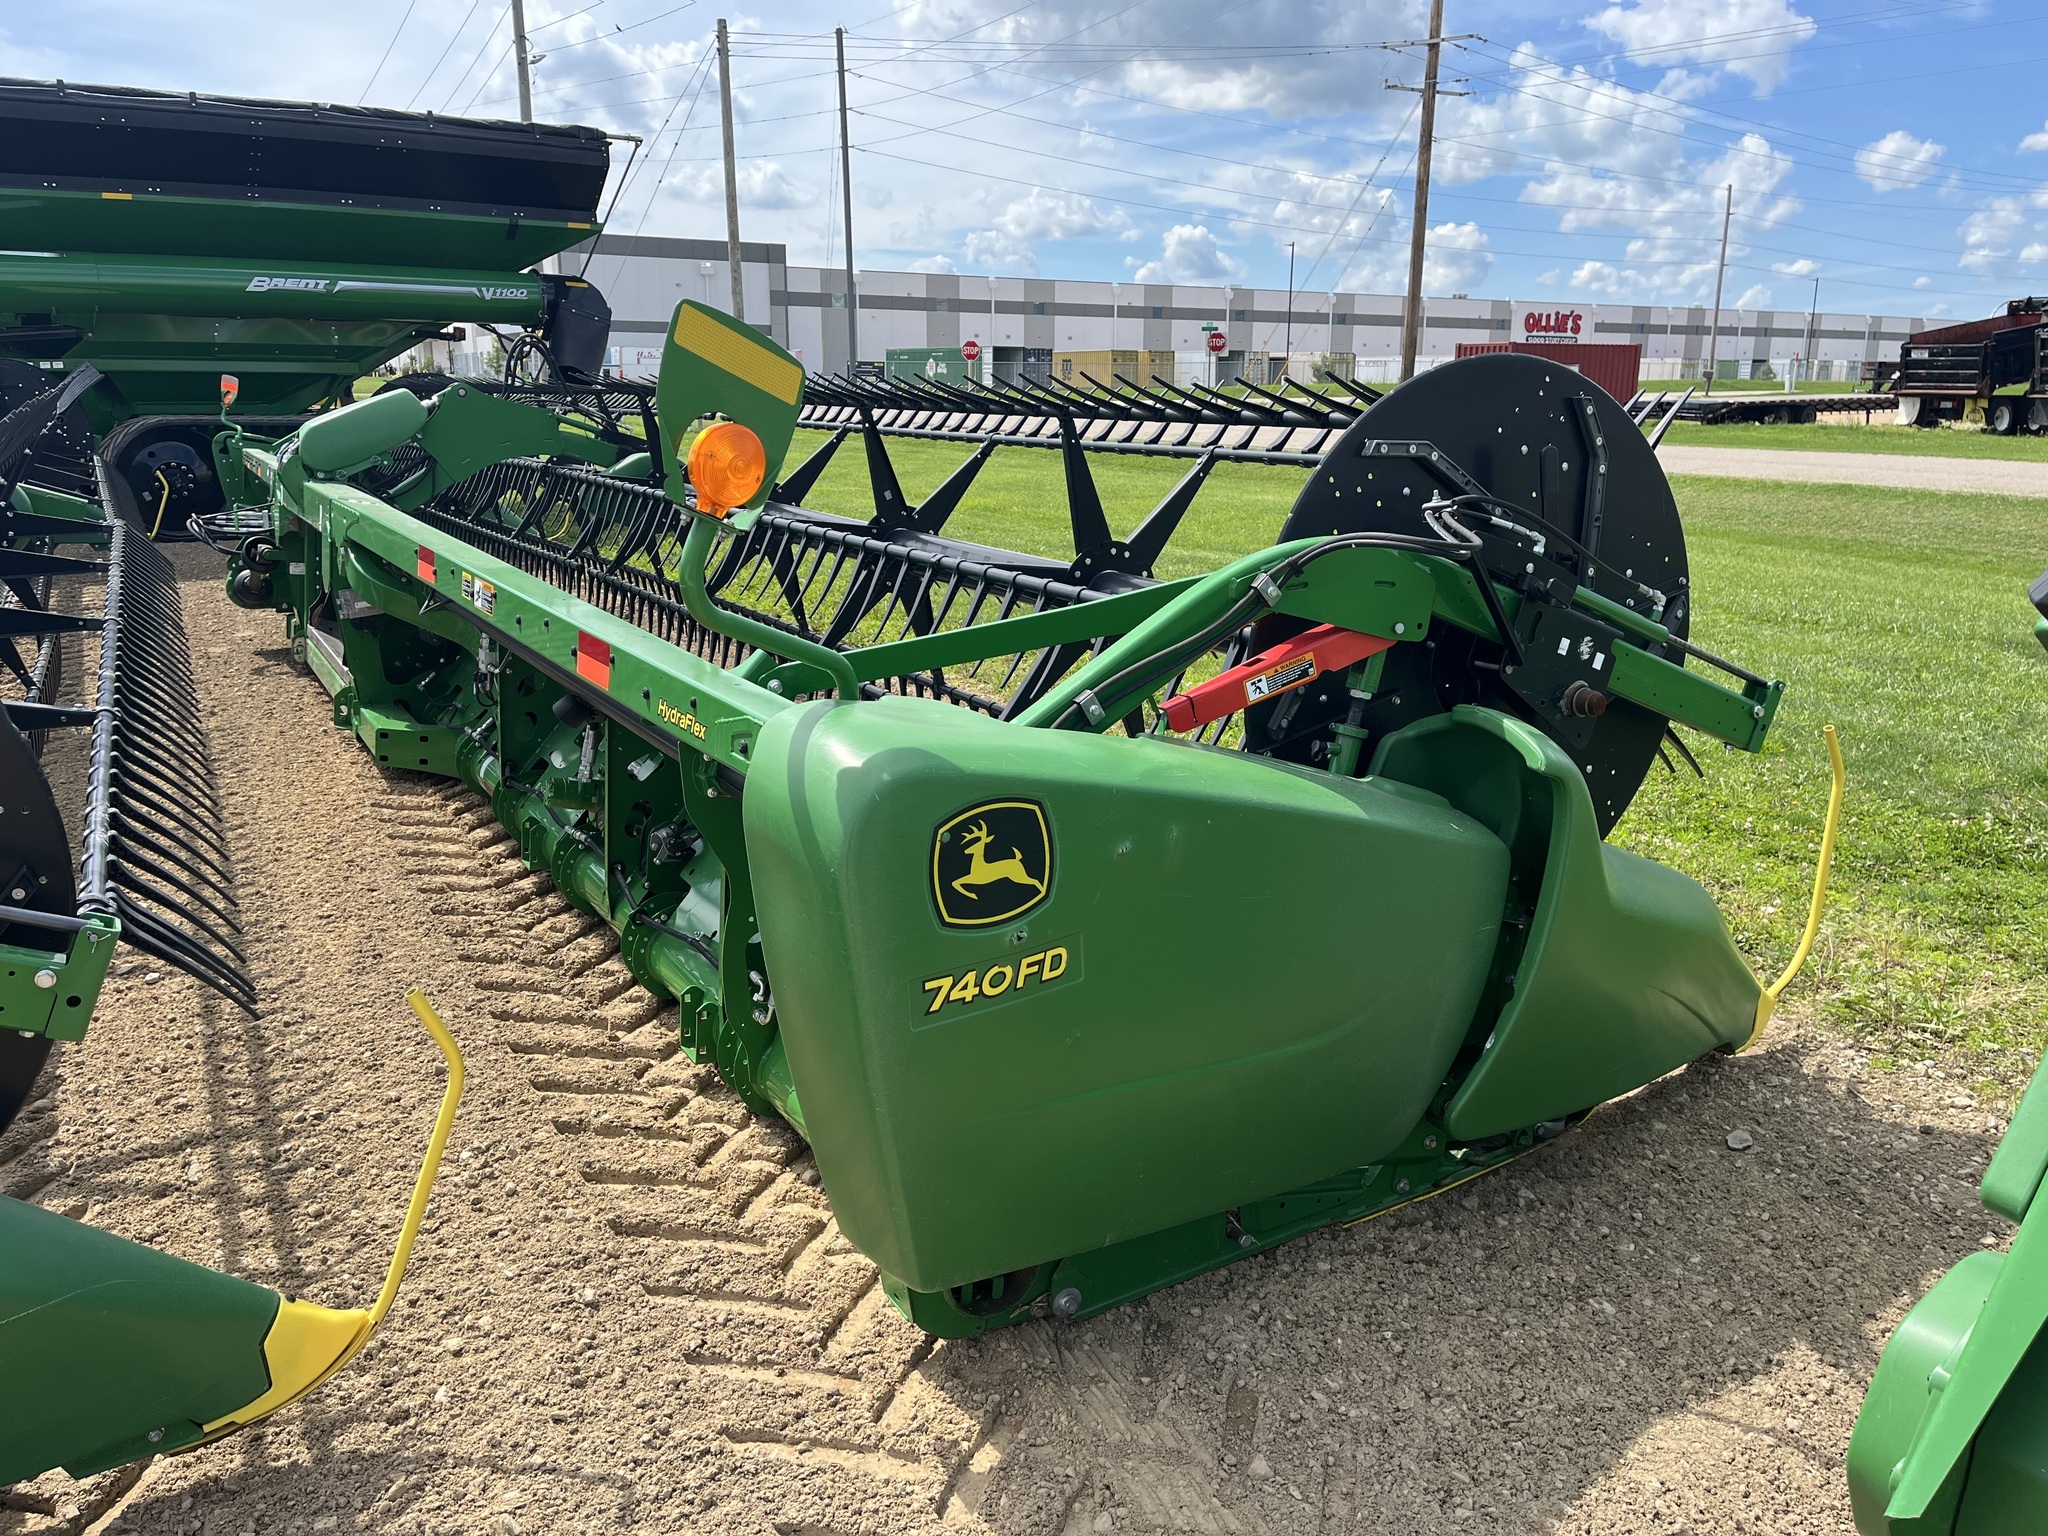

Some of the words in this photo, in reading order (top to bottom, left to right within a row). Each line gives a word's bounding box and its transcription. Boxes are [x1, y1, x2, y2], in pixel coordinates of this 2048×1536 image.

[245, 277, 330, 292] BRENT
[481, 287, 528, 300] V1100
[1208, 338, 1226, 346] STOP
[963, 346, 979, 355] STOP
[1280, 656, 1306, 670] WARNING
[658, 697, 707, 741] HydraFlex
[923, 946, 1068, 1015] 740FD
